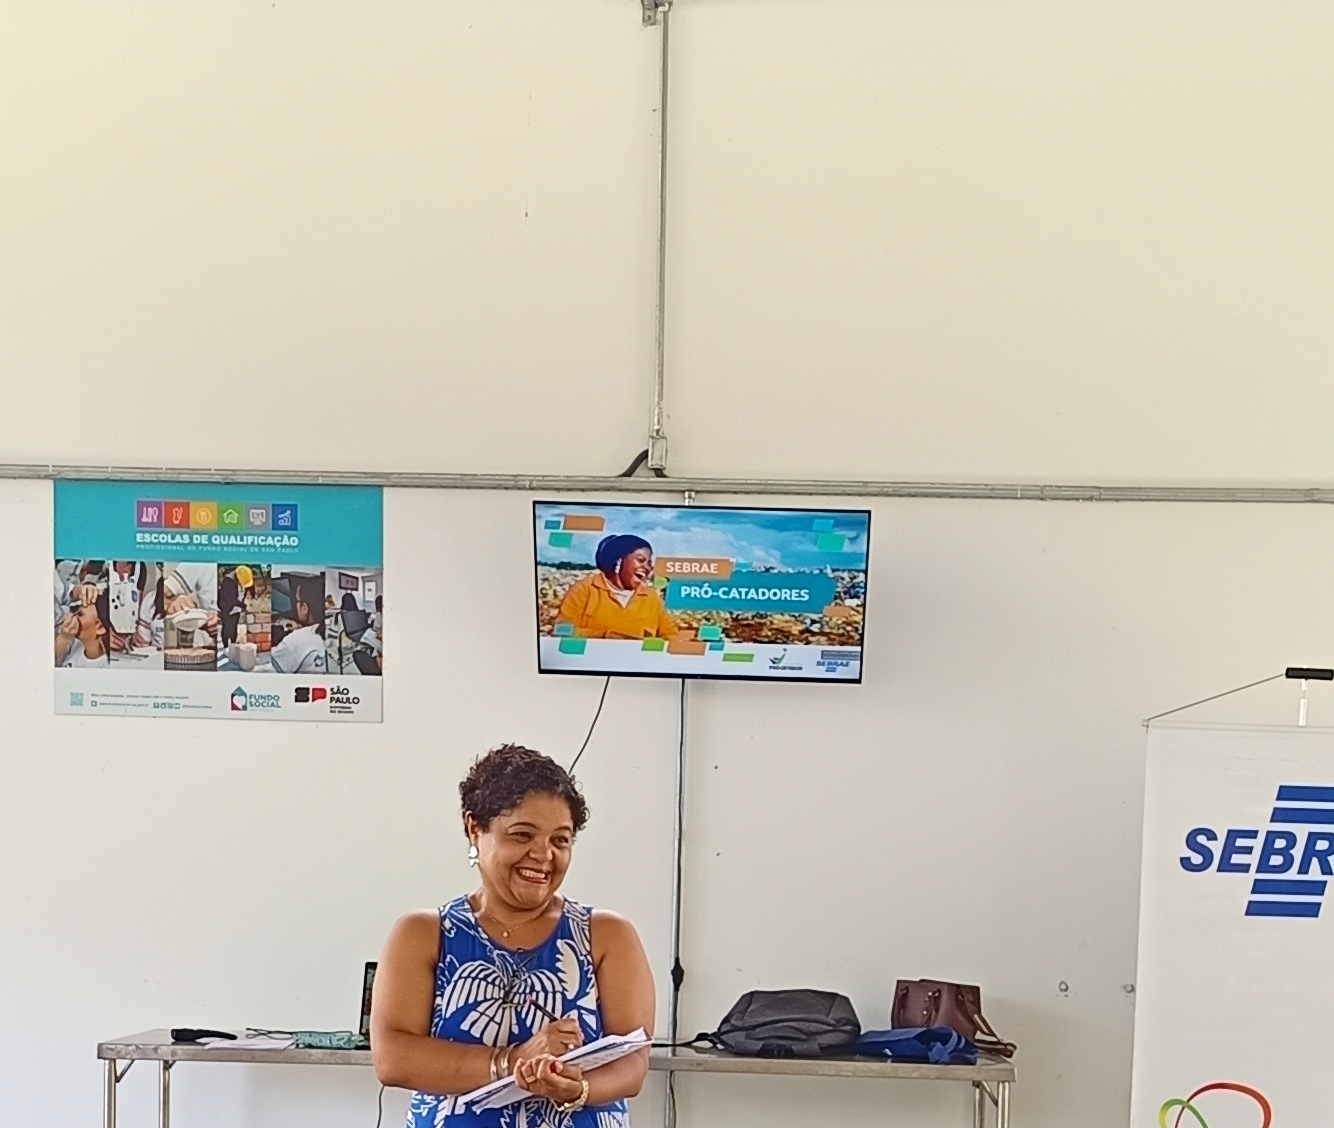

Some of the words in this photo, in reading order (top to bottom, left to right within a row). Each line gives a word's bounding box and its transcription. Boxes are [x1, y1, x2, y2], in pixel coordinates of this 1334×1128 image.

[136, 533, 190, 543] ESCOLAS
[193, 534, 208, 544] DE
[211, 534, 299, 547] QUALIFICAÇÃO
[665, 561, 719, 574] SEBRAE
[680, 583, 810, 601] PRÓ-CATADORES
[329, 685, 350, 696] SÃO
[248, 693, 281, 701] FUNDO
[329, 696, 361, 705] PAULO
[248, 700, 281, 709] SOCIAL
